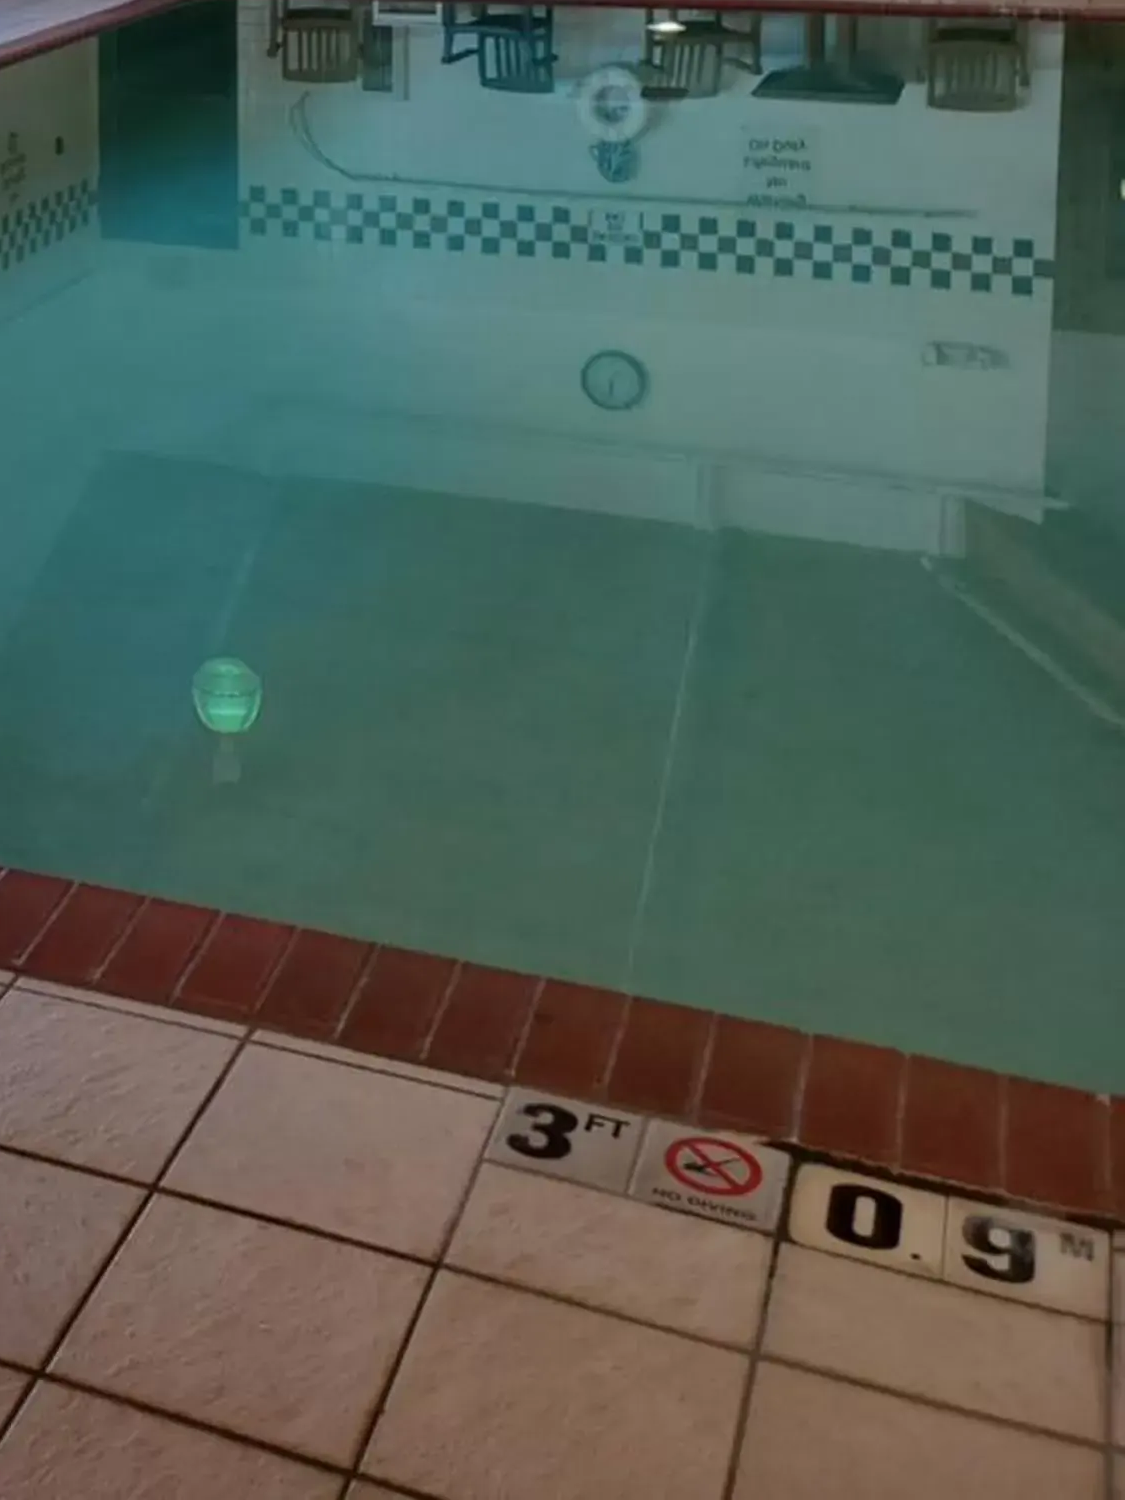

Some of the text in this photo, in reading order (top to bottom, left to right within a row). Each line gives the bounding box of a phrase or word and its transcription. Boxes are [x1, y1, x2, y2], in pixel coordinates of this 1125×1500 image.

[506, 1103, 631, 1160] 3 FT
[651, 1187, 758, 1222] NO DIVING
